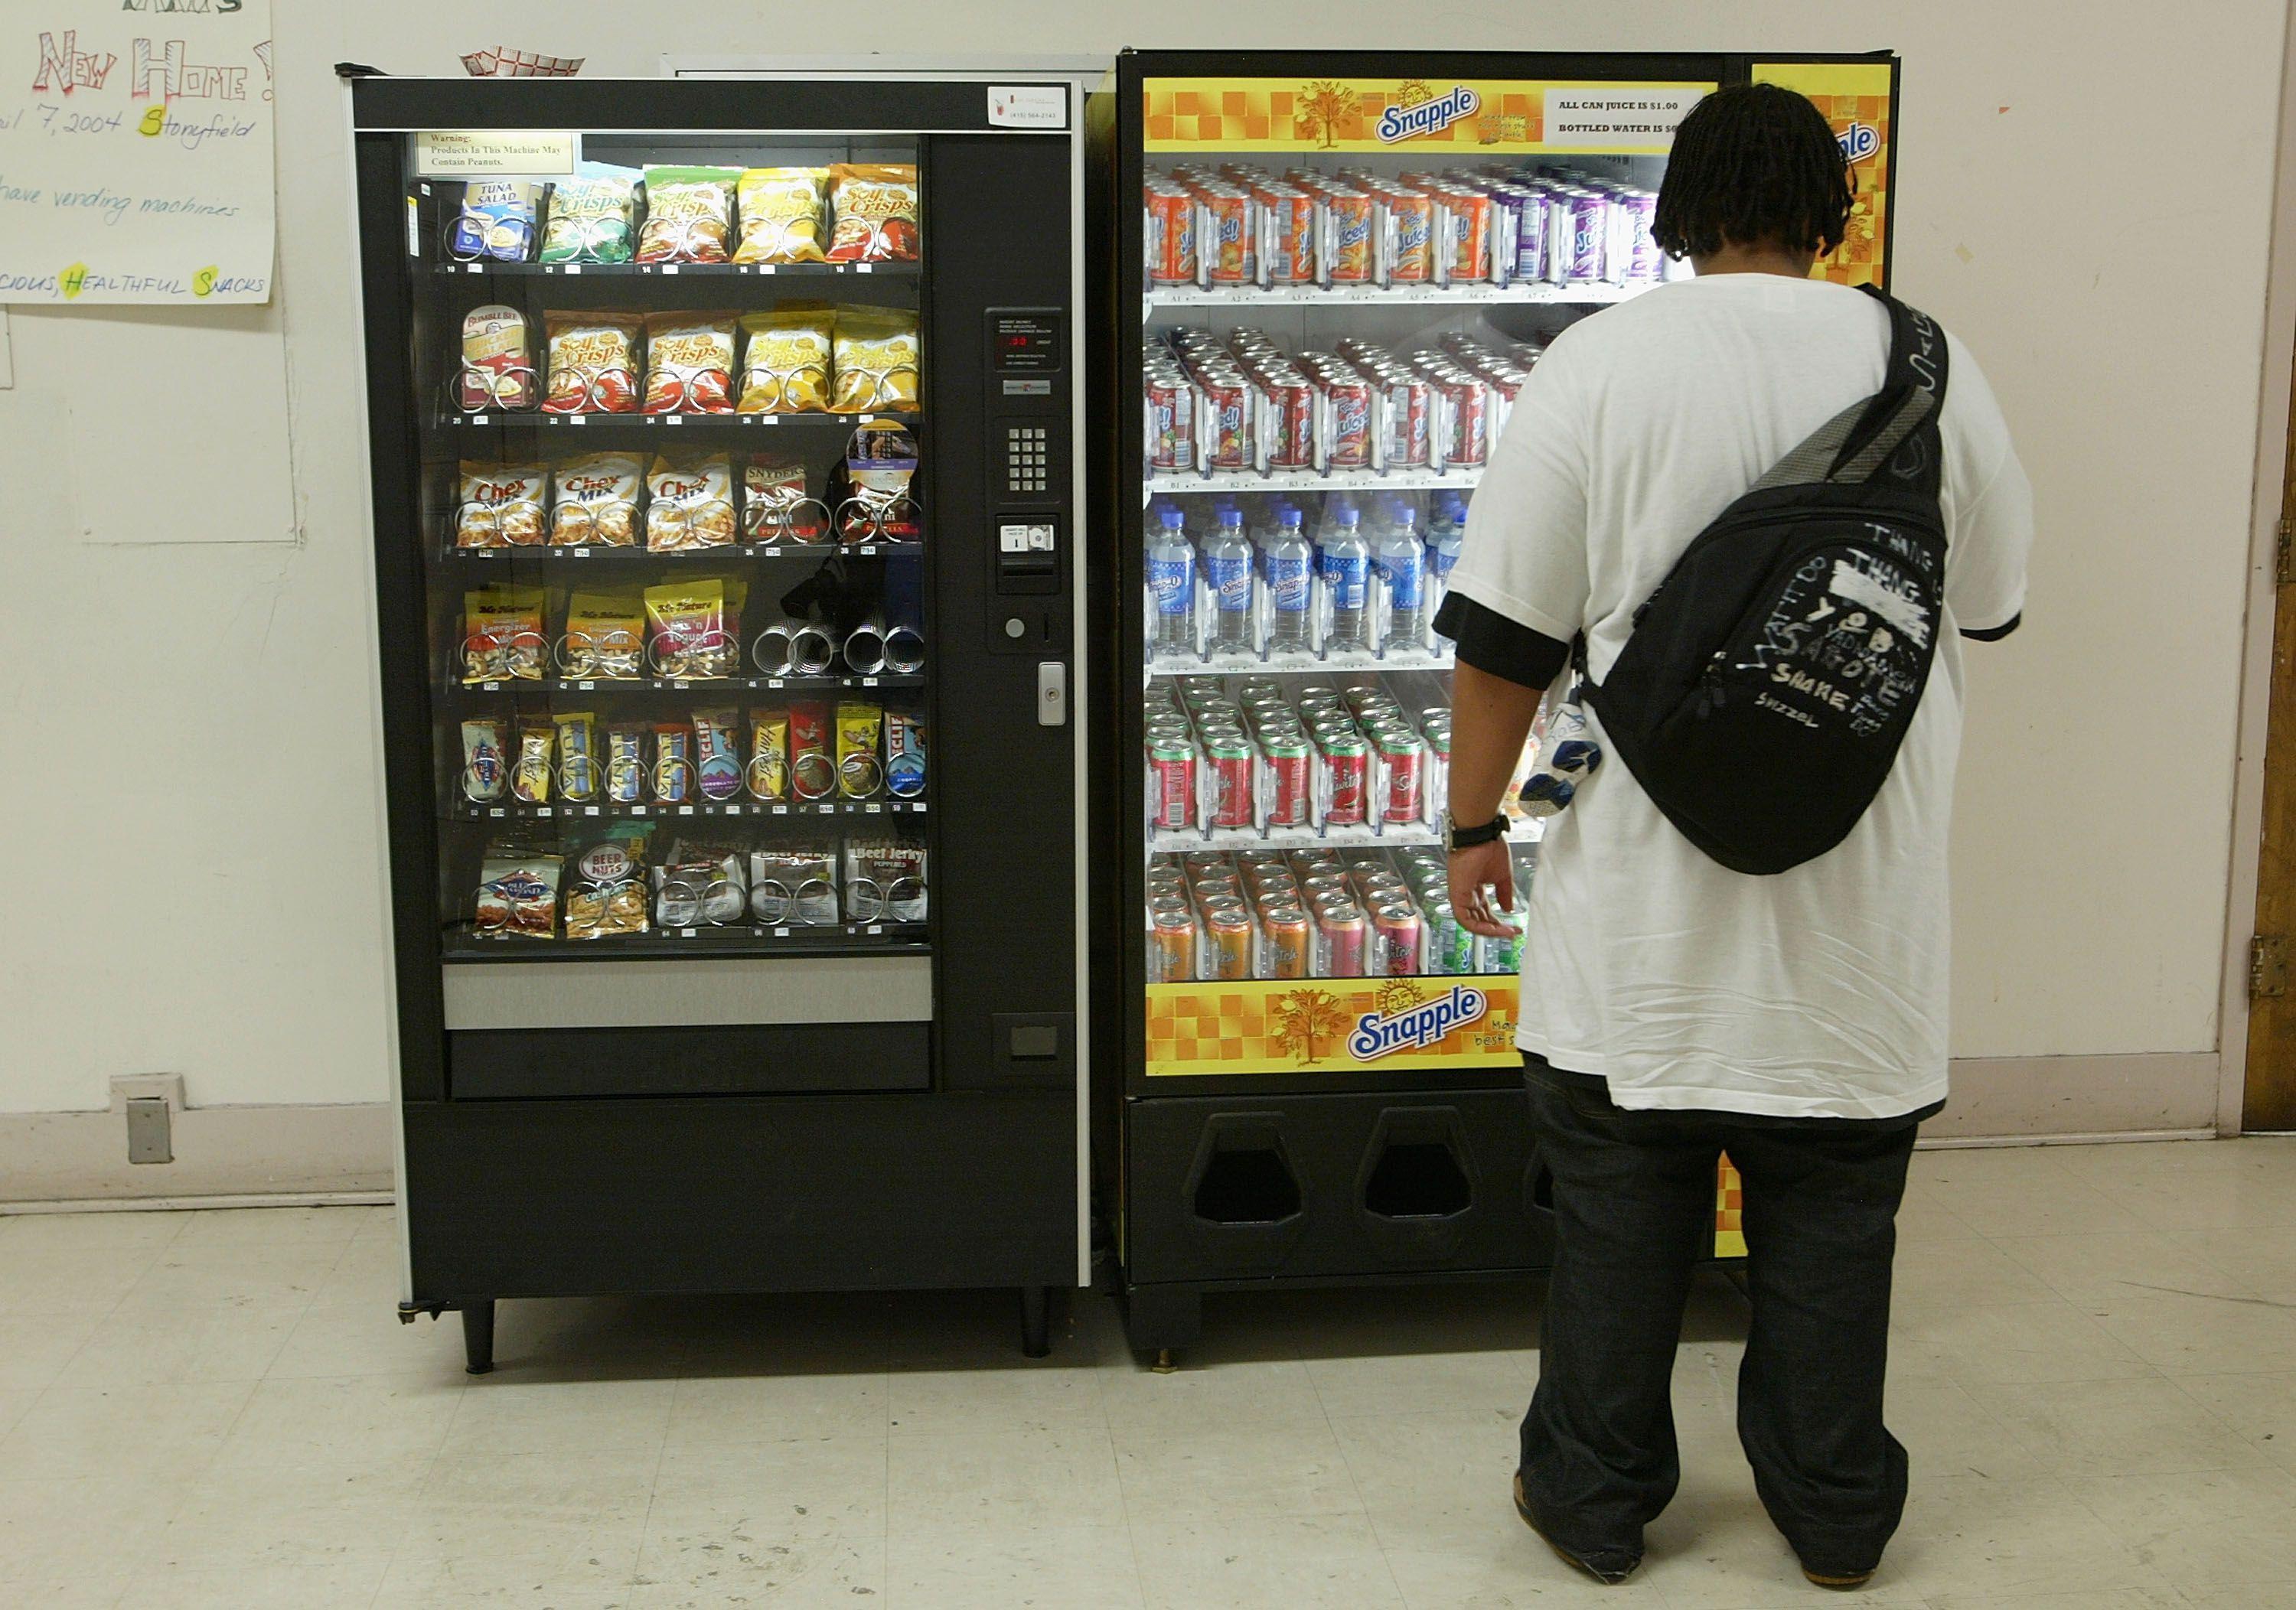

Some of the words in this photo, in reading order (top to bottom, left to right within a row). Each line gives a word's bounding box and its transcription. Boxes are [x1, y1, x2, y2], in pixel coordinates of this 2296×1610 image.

[1381, 86, 1474, 139] Snapple
[1606, 101, 1636, 111] JUICE
[63, 111, 122, 133] 2004
[139, 109, 256, 150] Stonyfield
[431, 134, 471, 144] Warning:
[431, 145, 468, 154] Products
[471, 145, 481, 154] In
[484, 145, 501, 154] This
[504, 145, 540, 154] Machine
[543, 145, 562, 155] May
[432, 158, 465, 166] Contain
[468, 158, 504, 166] Peanuts.
[481, 184, 512, 194] TUNA
[0, 175, 40, 204] have
[54, 187, 132, 226] vending
[139, 196, 239, 217] machines
[478, 192, 517, 205] SALAD
[66, 270, 186, 295] HEALTHFUL
[194, 271, 264, 296] SNACKS
[474, 477, 527, 502] Chex
[566, 475, 620, 492] Chex
[593, 853, 622, 865] BEER
[857, 848, 886, 859] Beef
[889, 848, 924, 863] Jerky
[592, 864, 622, 874] NUTS
[1355, 986, 1477, 1054] Snapple
[1474, 1034, 1505, 1046] best
